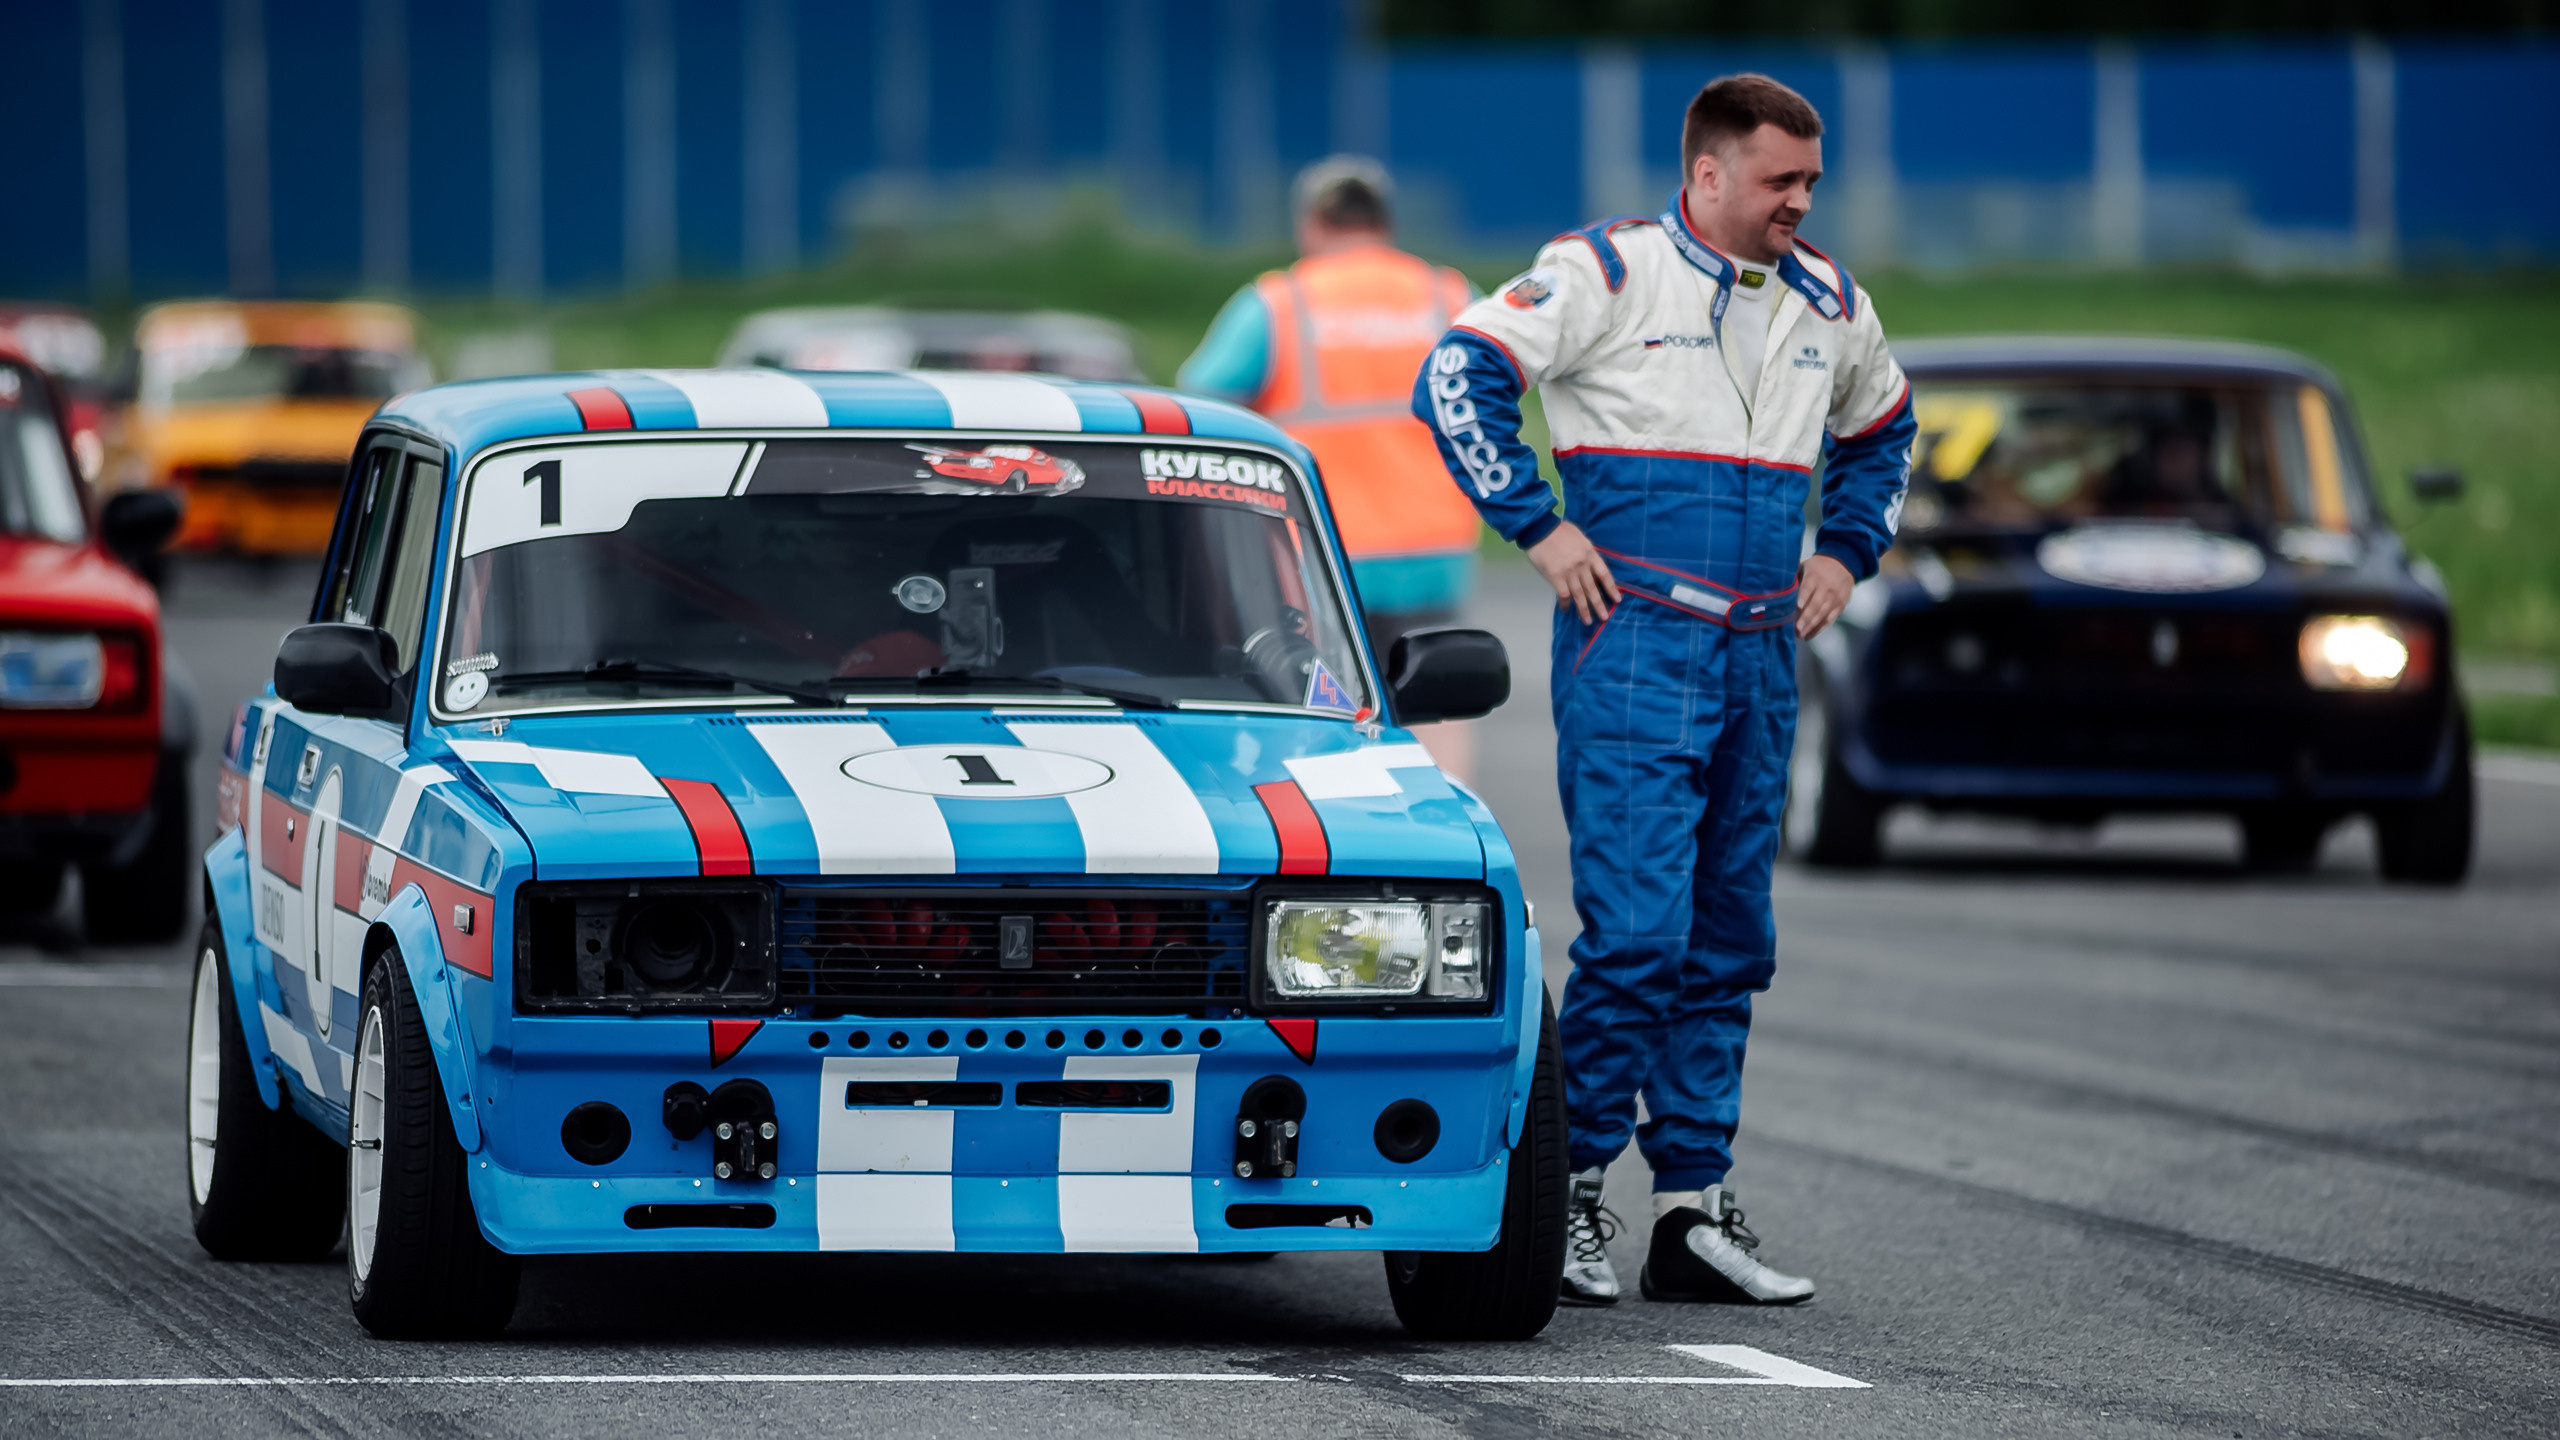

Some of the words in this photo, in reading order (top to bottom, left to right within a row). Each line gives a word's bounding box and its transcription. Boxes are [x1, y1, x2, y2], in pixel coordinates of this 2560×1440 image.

[1663, 334, 1714, 350] РОССИЯ
[1429, 342, 1512, 498] sparco
[1140, 450, 1286, 493] КУБОК
[523, 459, 562, 527] 1
[1147, 479, 1287, 512] КЛАССИКИ
[943, 755, 1017, 786] 1
